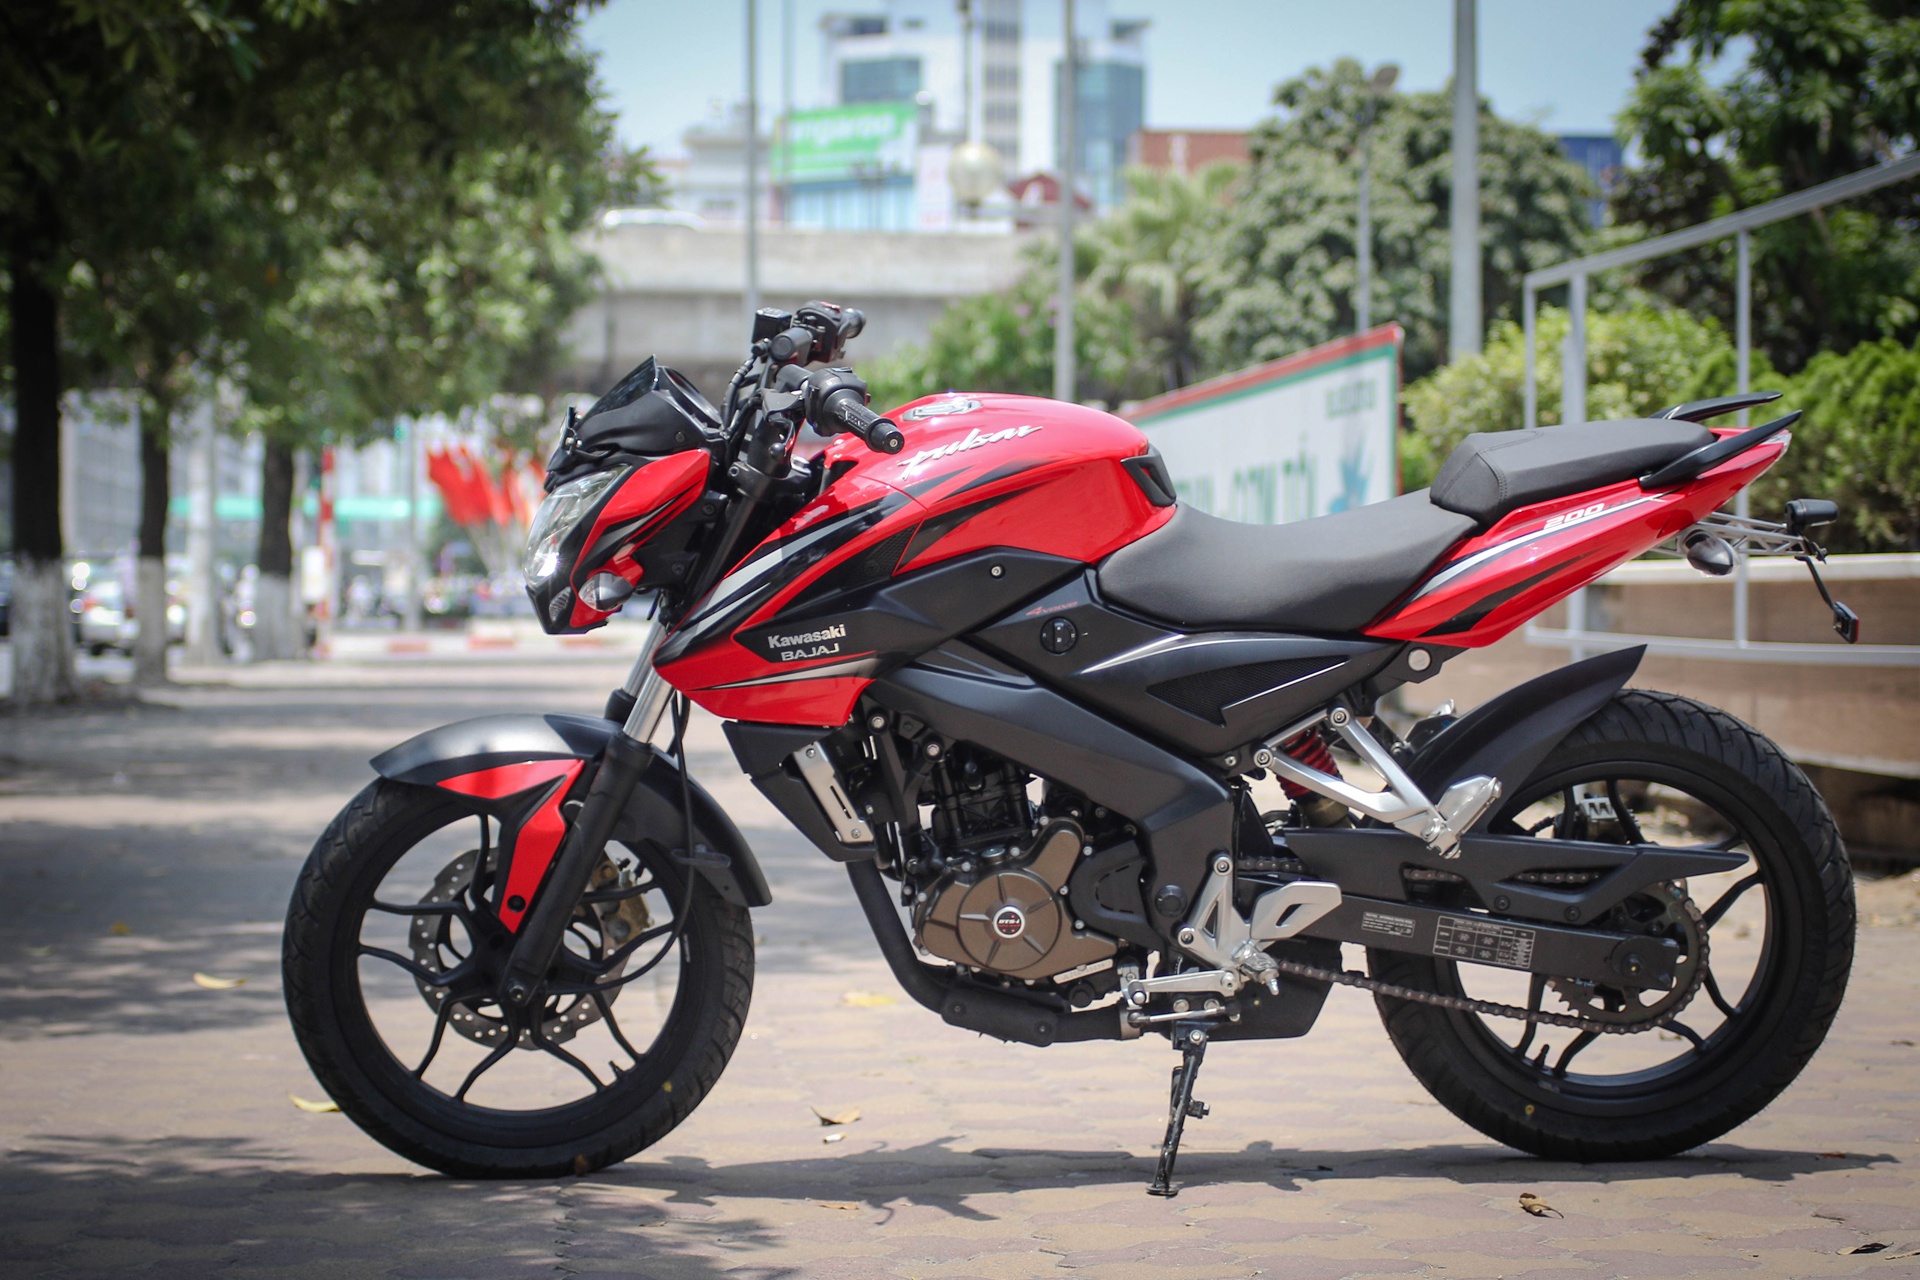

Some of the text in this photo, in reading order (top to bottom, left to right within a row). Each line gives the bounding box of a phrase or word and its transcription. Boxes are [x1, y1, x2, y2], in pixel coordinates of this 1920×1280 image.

[1543, 502, 1605, 530] 200
[767, 623, 847, 649] Kawasaki
[780, 642, 840, 661] BAJAJ
